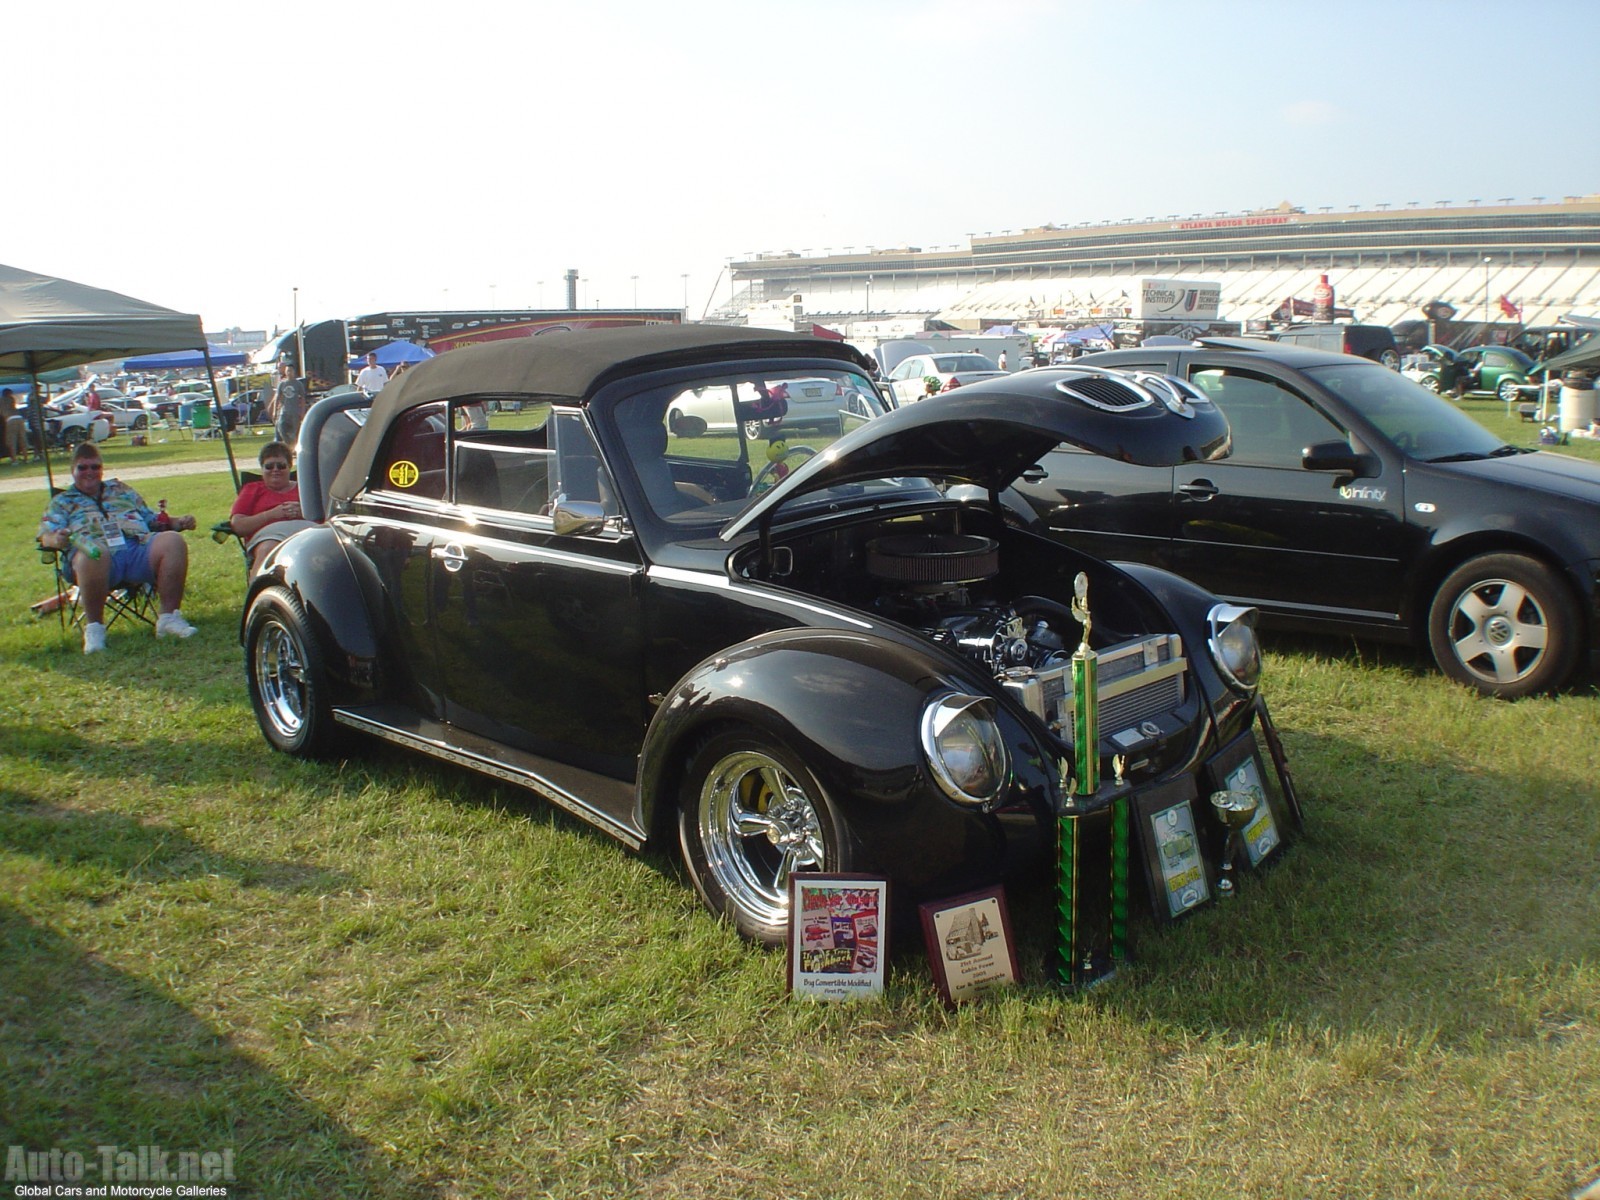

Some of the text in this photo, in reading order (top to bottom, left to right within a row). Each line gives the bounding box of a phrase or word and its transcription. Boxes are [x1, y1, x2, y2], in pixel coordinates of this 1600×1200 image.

[1180, 217, 1288, 229] ATLANTA MOTOR SPEEDWAY
[1142, 289, 1175, 297] TECHNICAL
[973, 954, 993, 963] Annual
[961, 966, 977, 974] Cabin
[803, 978, 872, 988] Bug Convertible Modified
[974, 973, 1006, 985] Motorcycle
